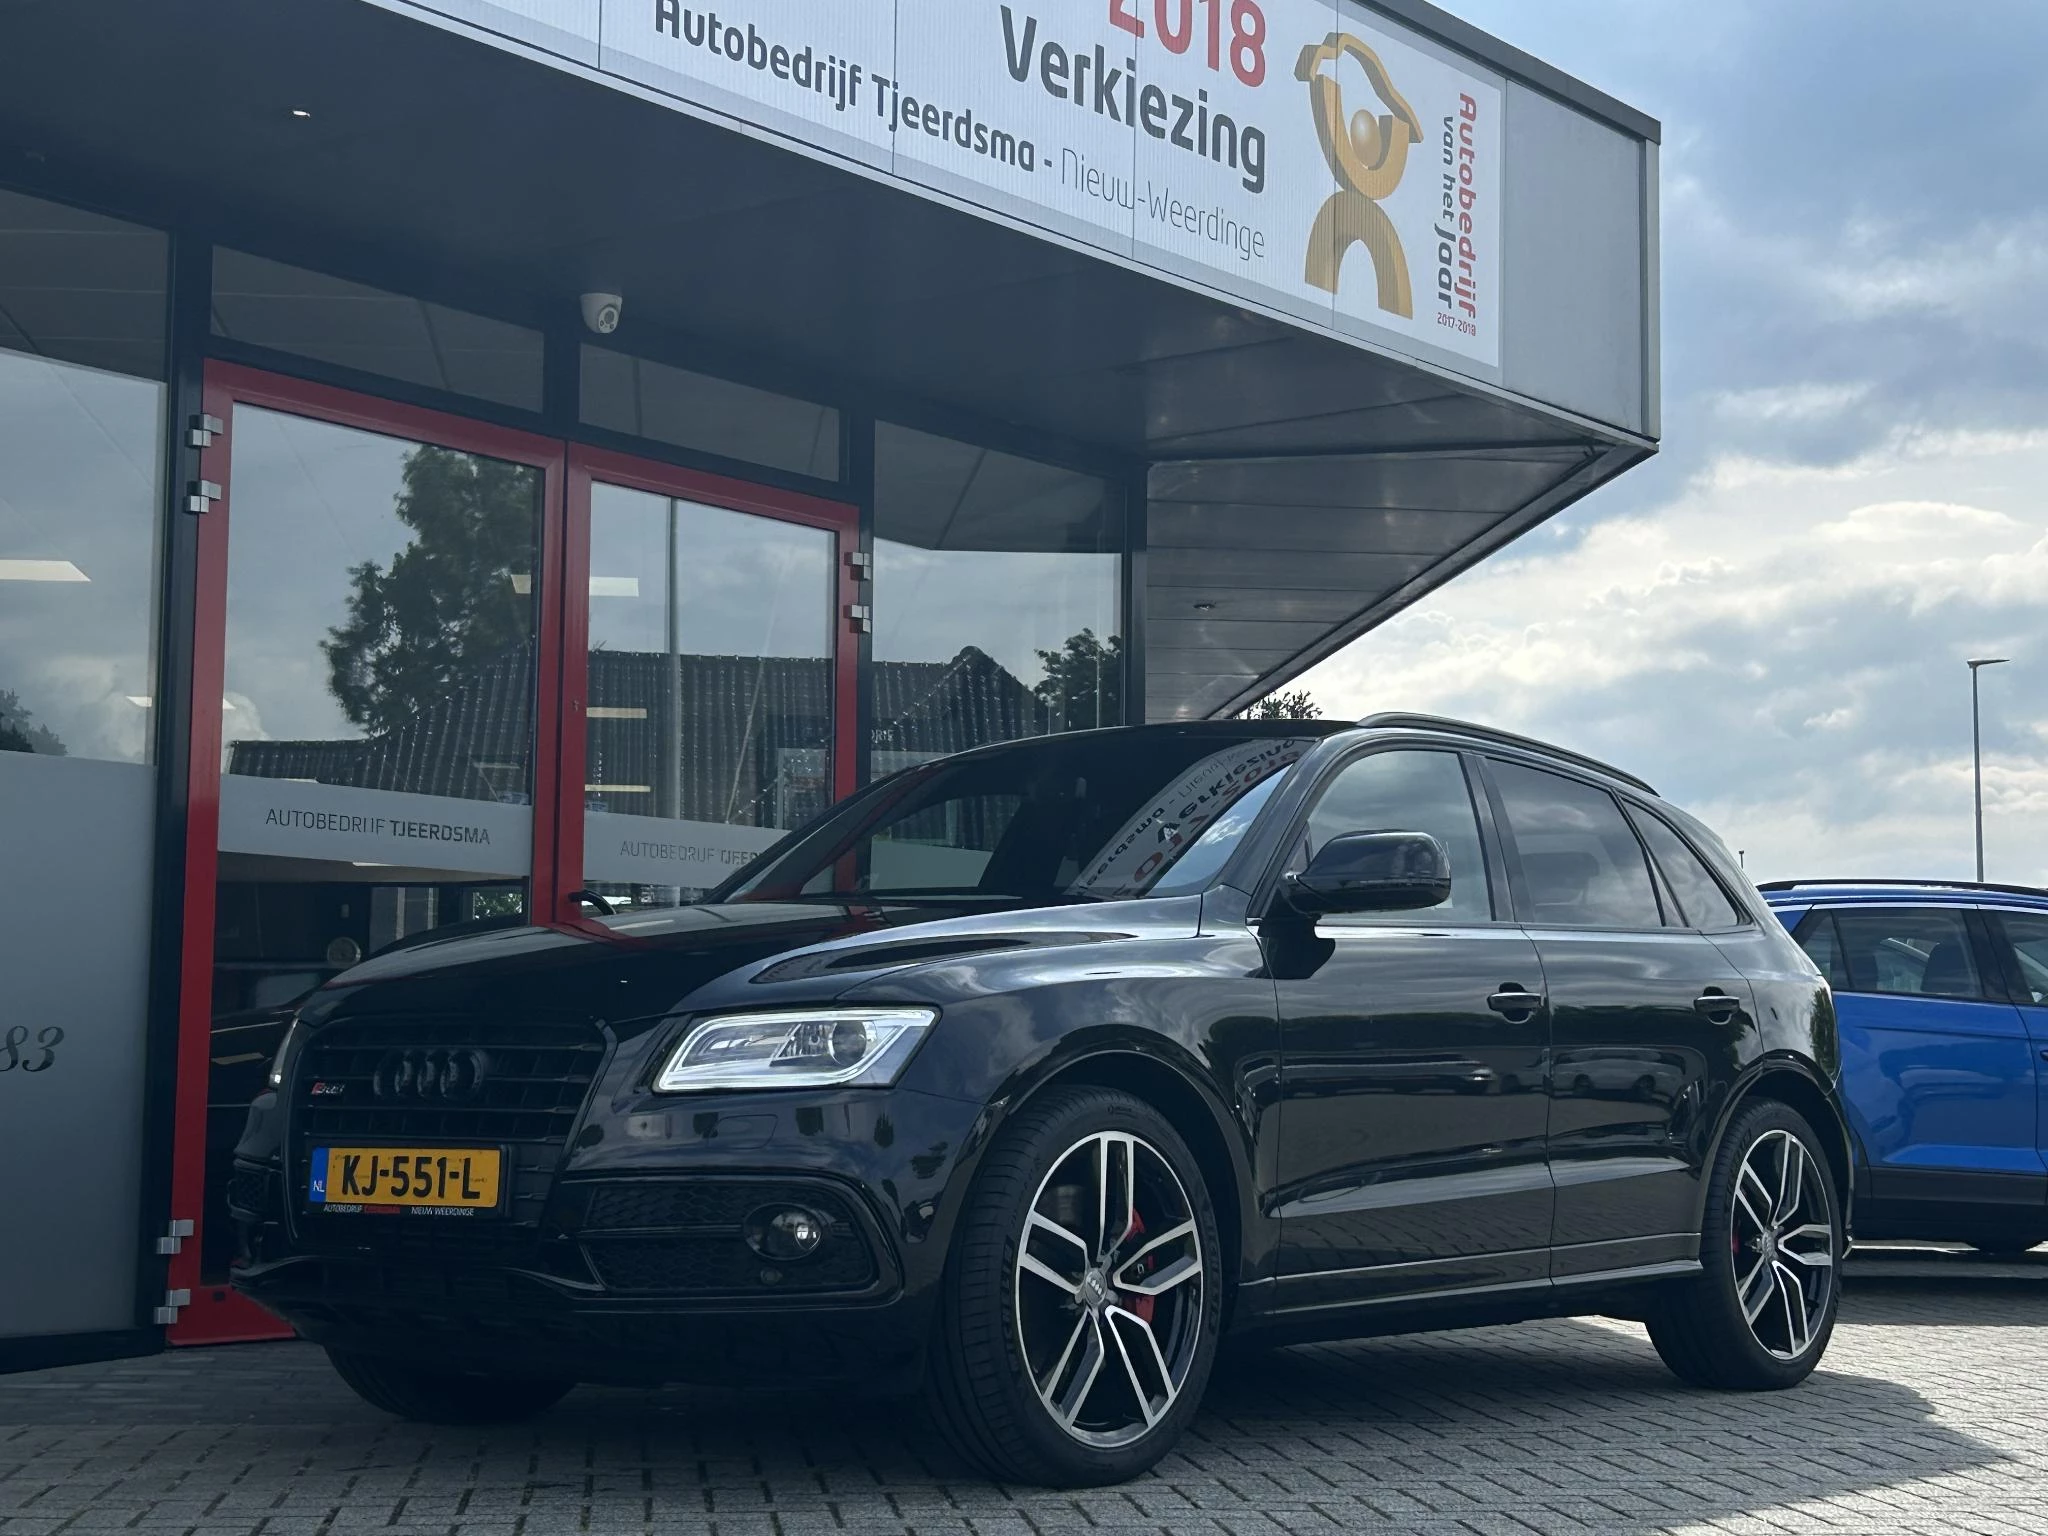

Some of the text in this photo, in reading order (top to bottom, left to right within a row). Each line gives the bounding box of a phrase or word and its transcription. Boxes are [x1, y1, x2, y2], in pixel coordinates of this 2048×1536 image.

[655, 0, 862, 112] Autobedrijf
[871, 73, 1035, 173] Tjeerdsma
[1000, 4, 1266, 194] Verkiezing
[1442, 116, 1454, 166] van
[1442, 172, 1456, 222] het
[1455, 92, 1477, 319] Autobedrijf
[1437, 311, 1477, 337] 2017-2018
[265, 808, 491, 845] AUTOBEDRIJF TJEERDSMA
[619, 840, 715, 862] AUTOBEDRIJF
[0, 1025, 65, 1072] 83
[313, 1179, 326, 1193] NL
[341, 1154, 481, 1200] KJ-551-L
